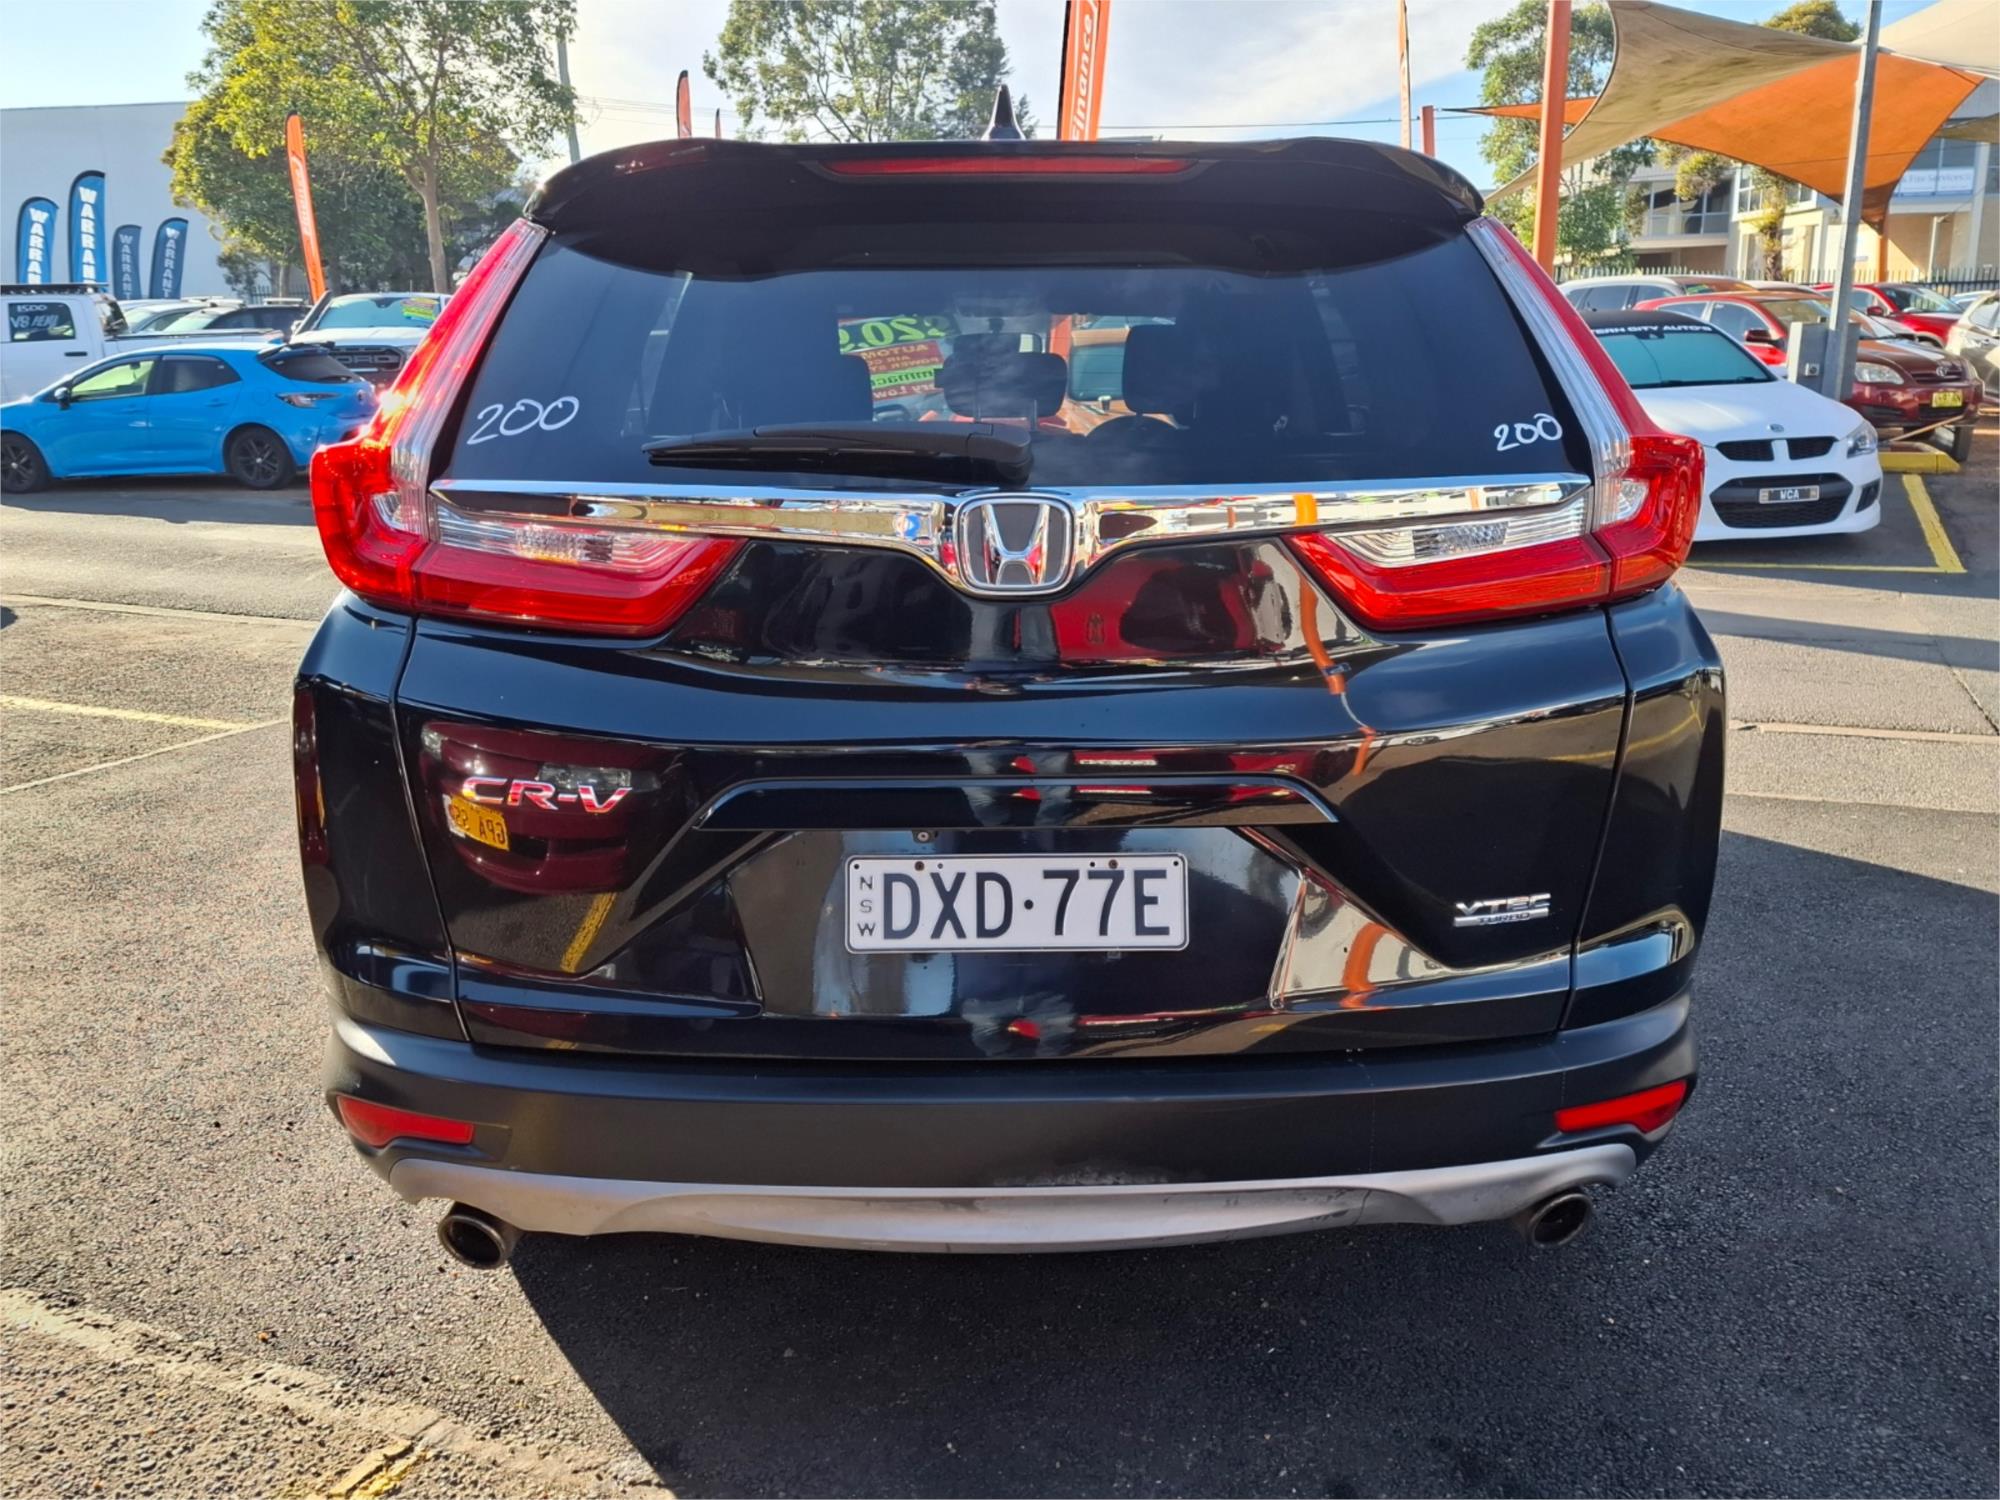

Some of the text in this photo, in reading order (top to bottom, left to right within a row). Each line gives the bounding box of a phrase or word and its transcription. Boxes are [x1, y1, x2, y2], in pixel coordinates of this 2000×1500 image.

[161, 226, 181, 298] WARRANT
[335, 355, 400, 364] ORD
[466, 396, 580, 445] 200
[1494, 413, 1563, 451] 200
[1780, 489, 1799, 500] WCA
[461, 776, 633, 814] CR-V
[857, 876, 876, 937] NSW
[1456, 893, 1551, 916] VTEC
